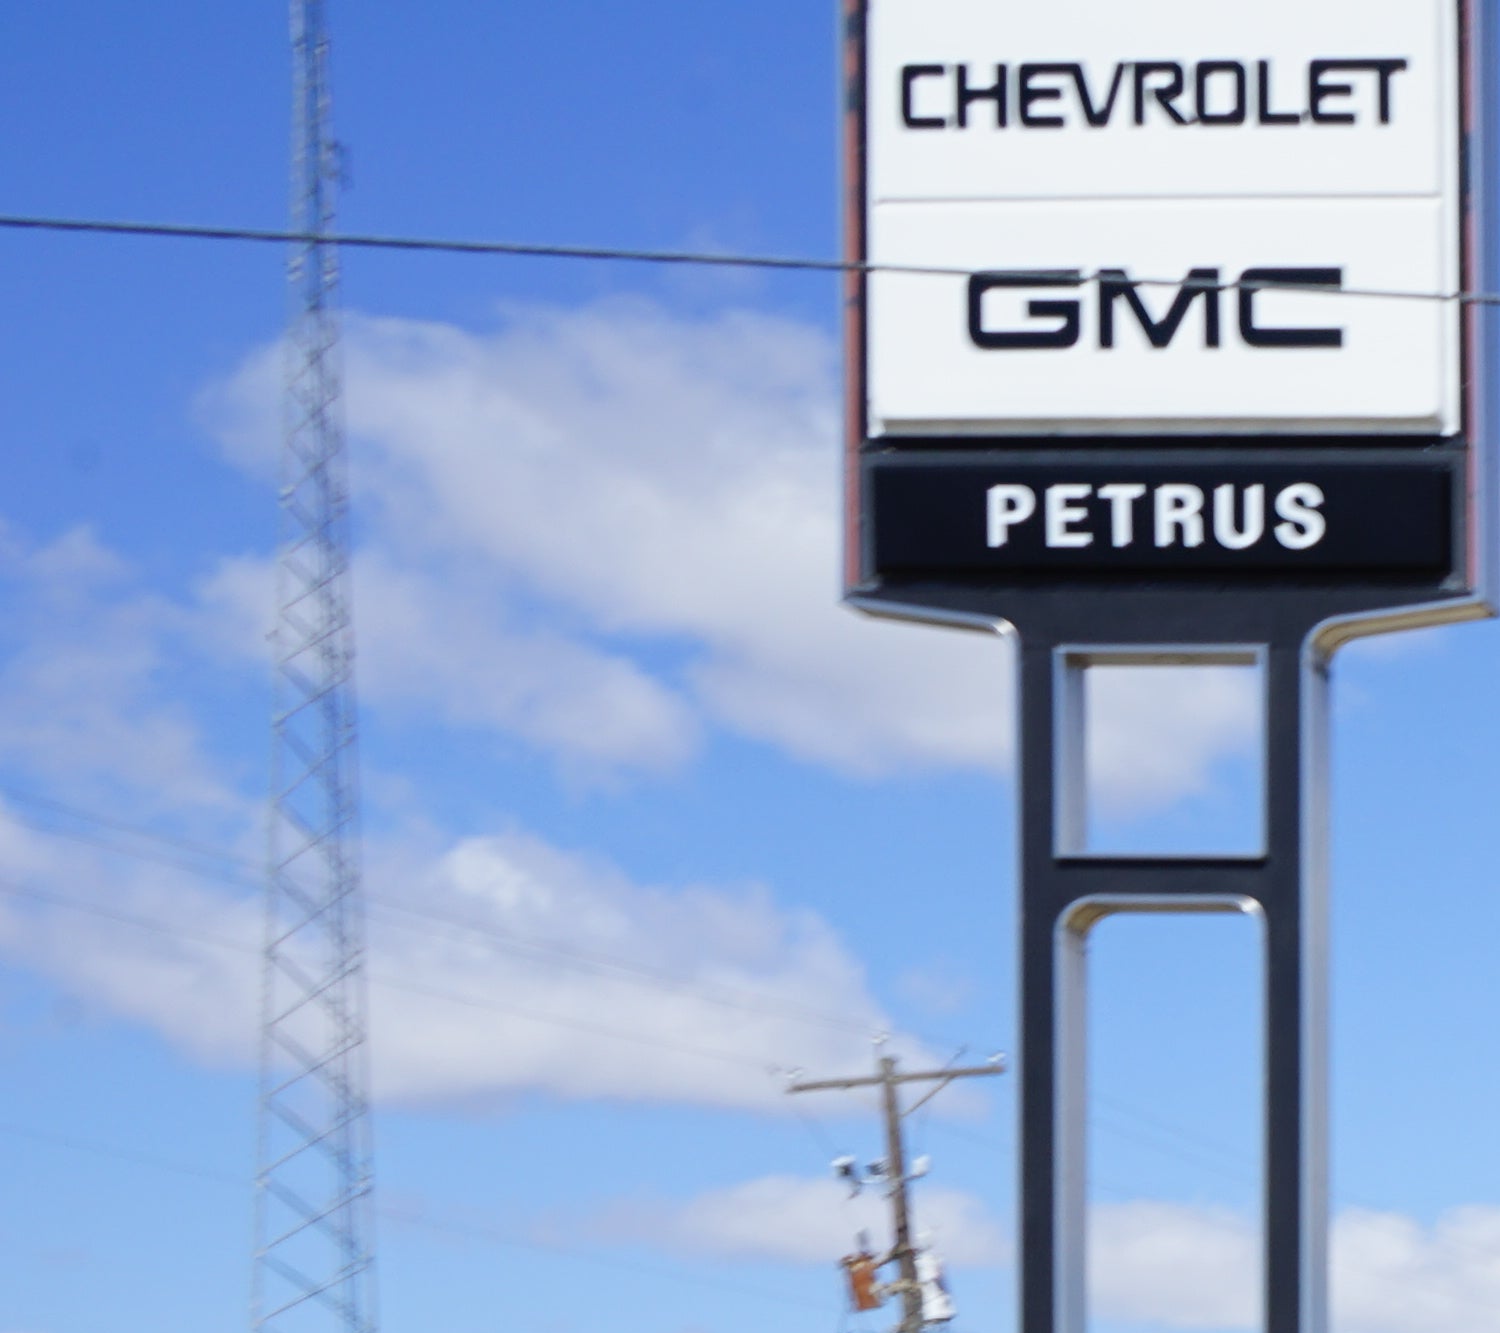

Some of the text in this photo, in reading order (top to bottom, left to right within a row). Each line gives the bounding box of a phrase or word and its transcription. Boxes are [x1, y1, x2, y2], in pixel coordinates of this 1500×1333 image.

[901, 58, 1407, 129] CHEVROLET
[966, 267, 1343, 350] GMC
[986, 483, 1327, 550] PETRUS
